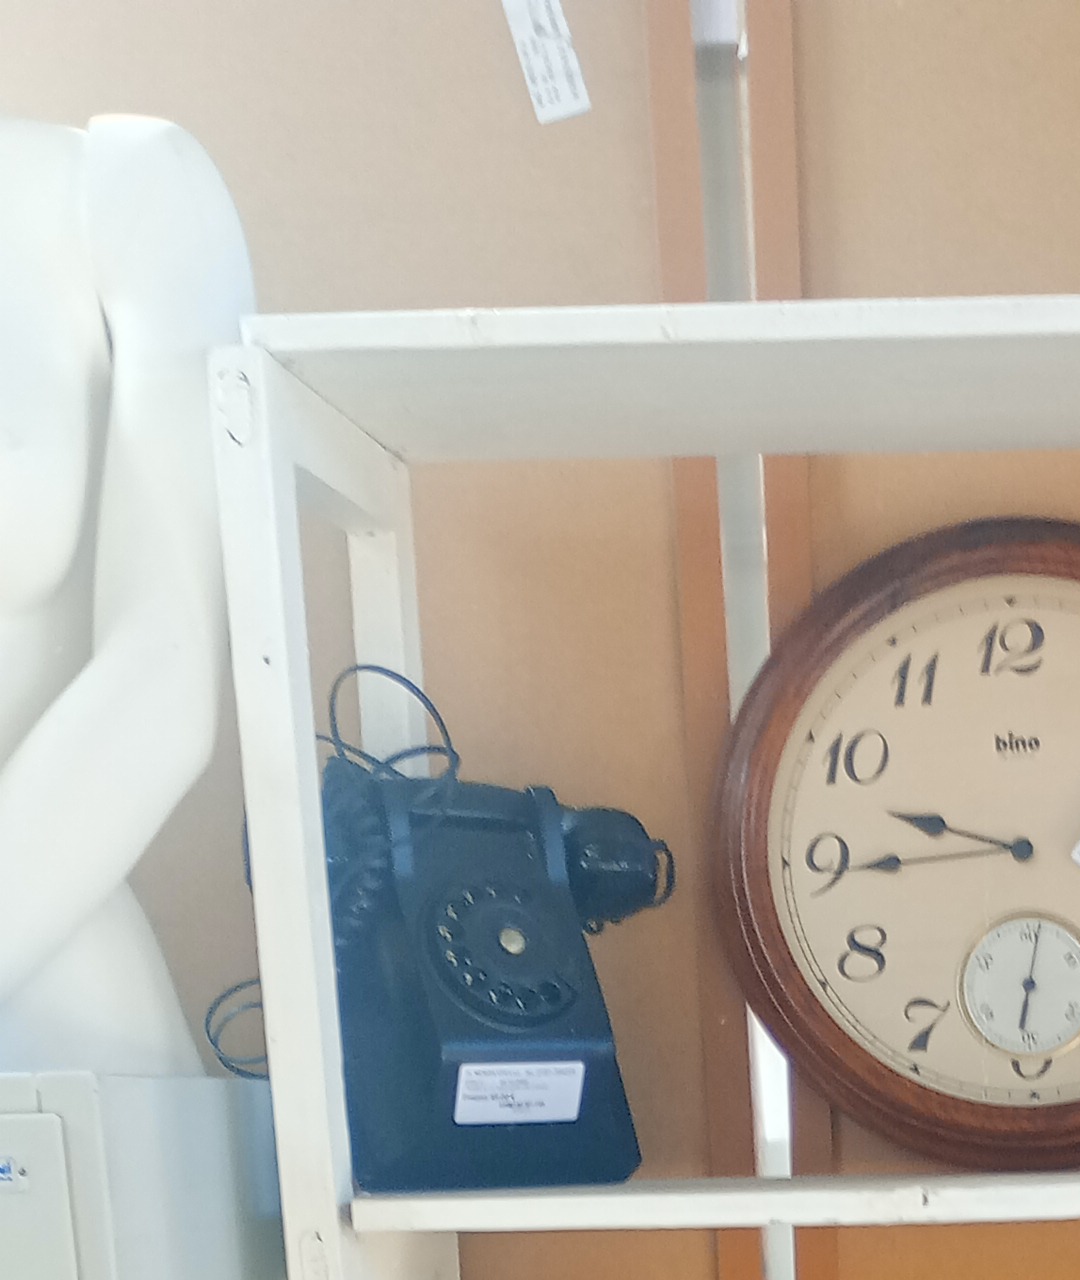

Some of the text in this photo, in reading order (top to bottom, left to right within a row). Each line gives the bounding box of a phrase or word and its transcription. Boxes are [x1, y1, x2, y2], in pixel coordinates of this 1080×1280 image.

[980, 618, 1045, 675] 12
[894, 652, 939, 707] 11
[825, 729, 889, 786] 10
[804, 833, 852, 898] 9
[837, 924, 887, 983] 8
[904, 996, 950, 1053] 7
